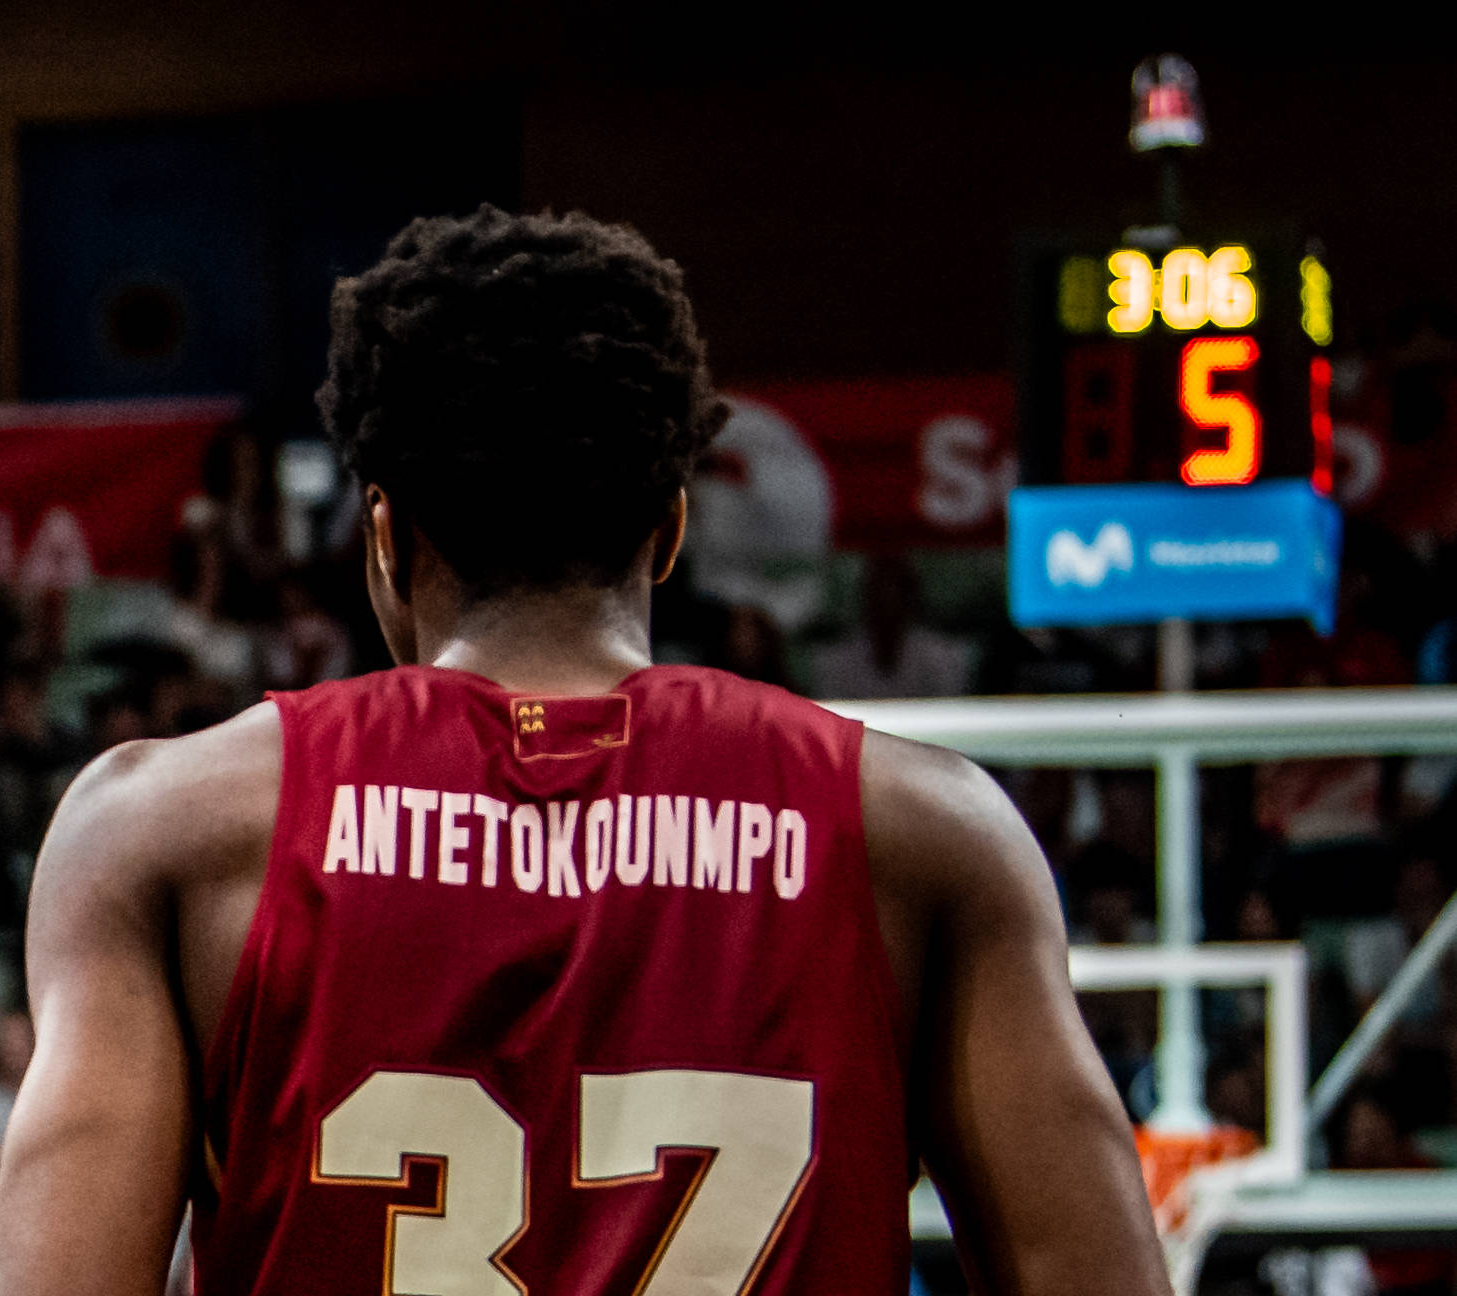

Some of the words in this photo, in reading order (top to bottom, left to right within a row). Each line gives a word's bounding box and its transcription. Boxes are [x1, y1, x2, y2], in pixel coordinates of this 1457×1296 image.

[1107, 245, 1257, 333] 3:06
[1180, 336, 1261, 486] 5
[322, 784, 807, 900] ANTETOKOUNMPO
